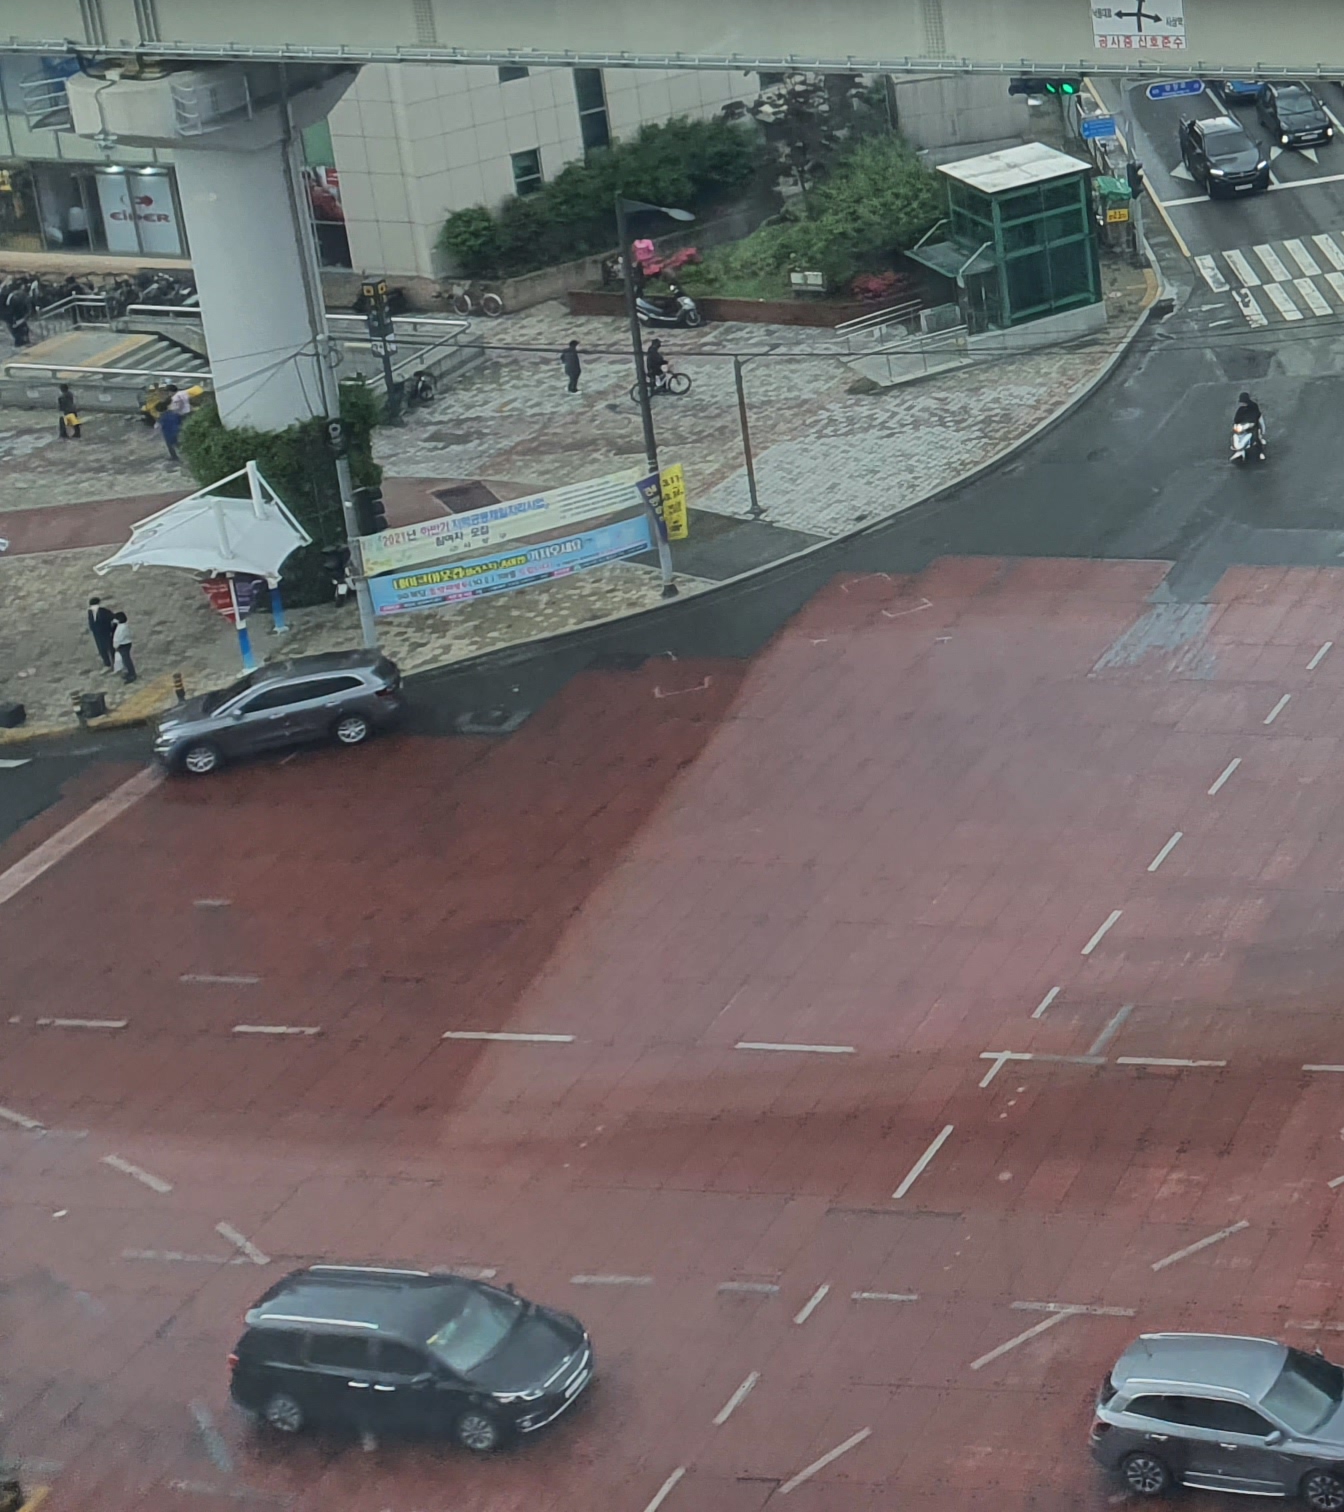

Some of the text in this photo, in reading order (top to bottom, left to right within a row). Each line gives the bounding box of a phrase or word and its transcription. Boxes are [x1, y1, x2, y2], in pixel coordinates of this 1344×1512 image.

[1098, 35, 1184, 48] 공사중 신호준수
[470, 525, 491, 540] 모집
